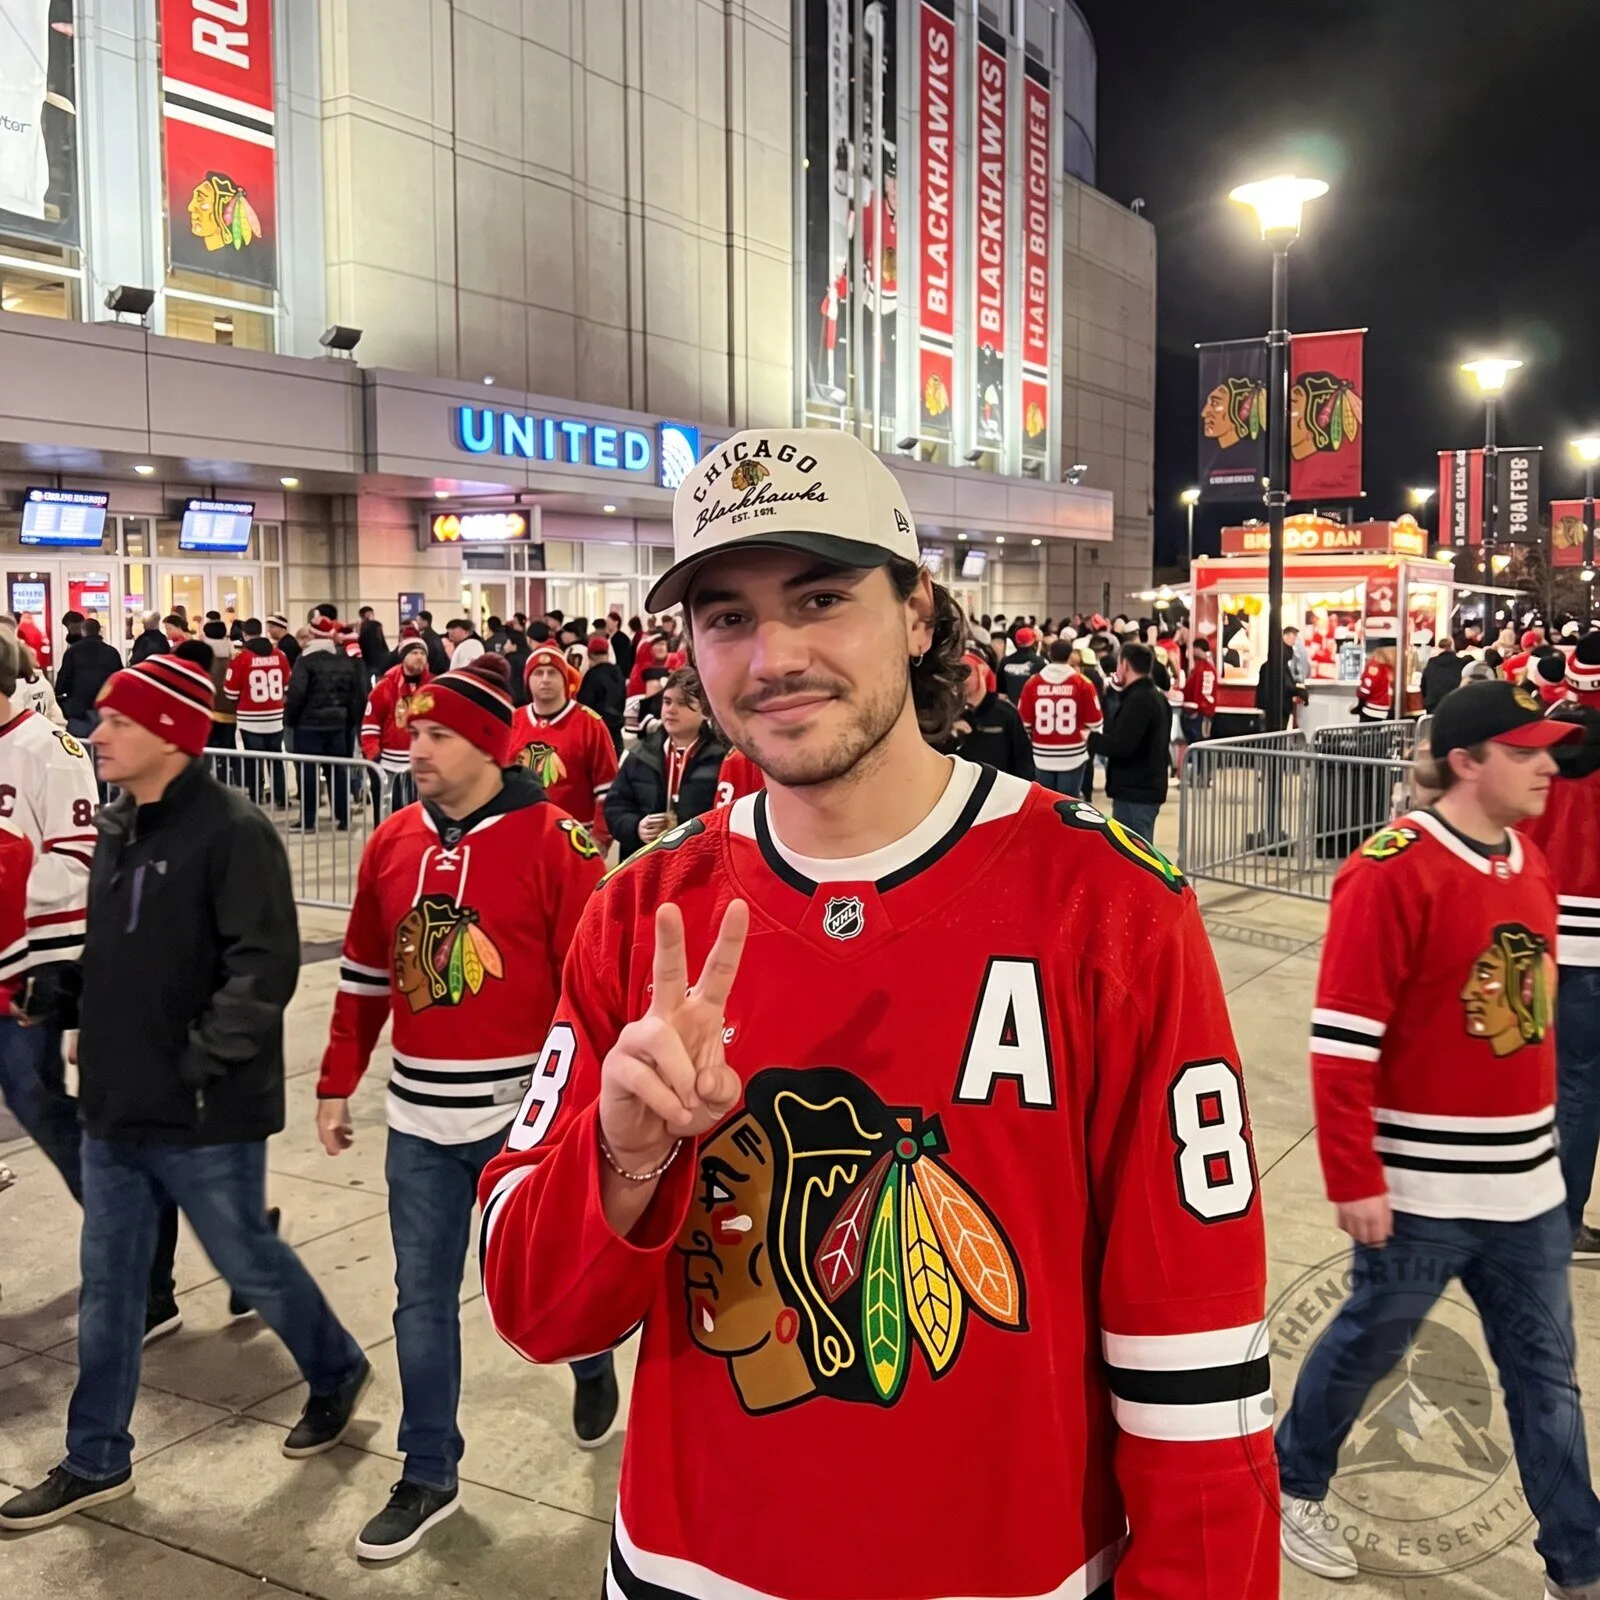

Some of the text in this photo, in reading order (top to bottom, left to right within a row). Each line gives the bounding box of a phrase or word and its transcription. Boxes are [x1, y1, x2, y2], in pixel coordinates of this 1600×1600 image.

[927, 27, 950, 316] BLACKHAWKS
[981, 59, 1003, 333] BLACKHAWKS
[460, 405, 651, 472] UNITED
[693, 439, 818, 503] CHICAGO
[693, 481, 829, 538] Blackhawks
[731, 511, 751, 525] EST.
[249, 668, 283, 704] 88
[1035, 698, 1077, 736] 88
[72, 799, 99, 827] 8
[832, 908, 856, 930] NHL
[956, 957, 1054, 1108] A
[505, 1022, 578, 1153] 8
[1168, 1058, 1258, 1224] 8
